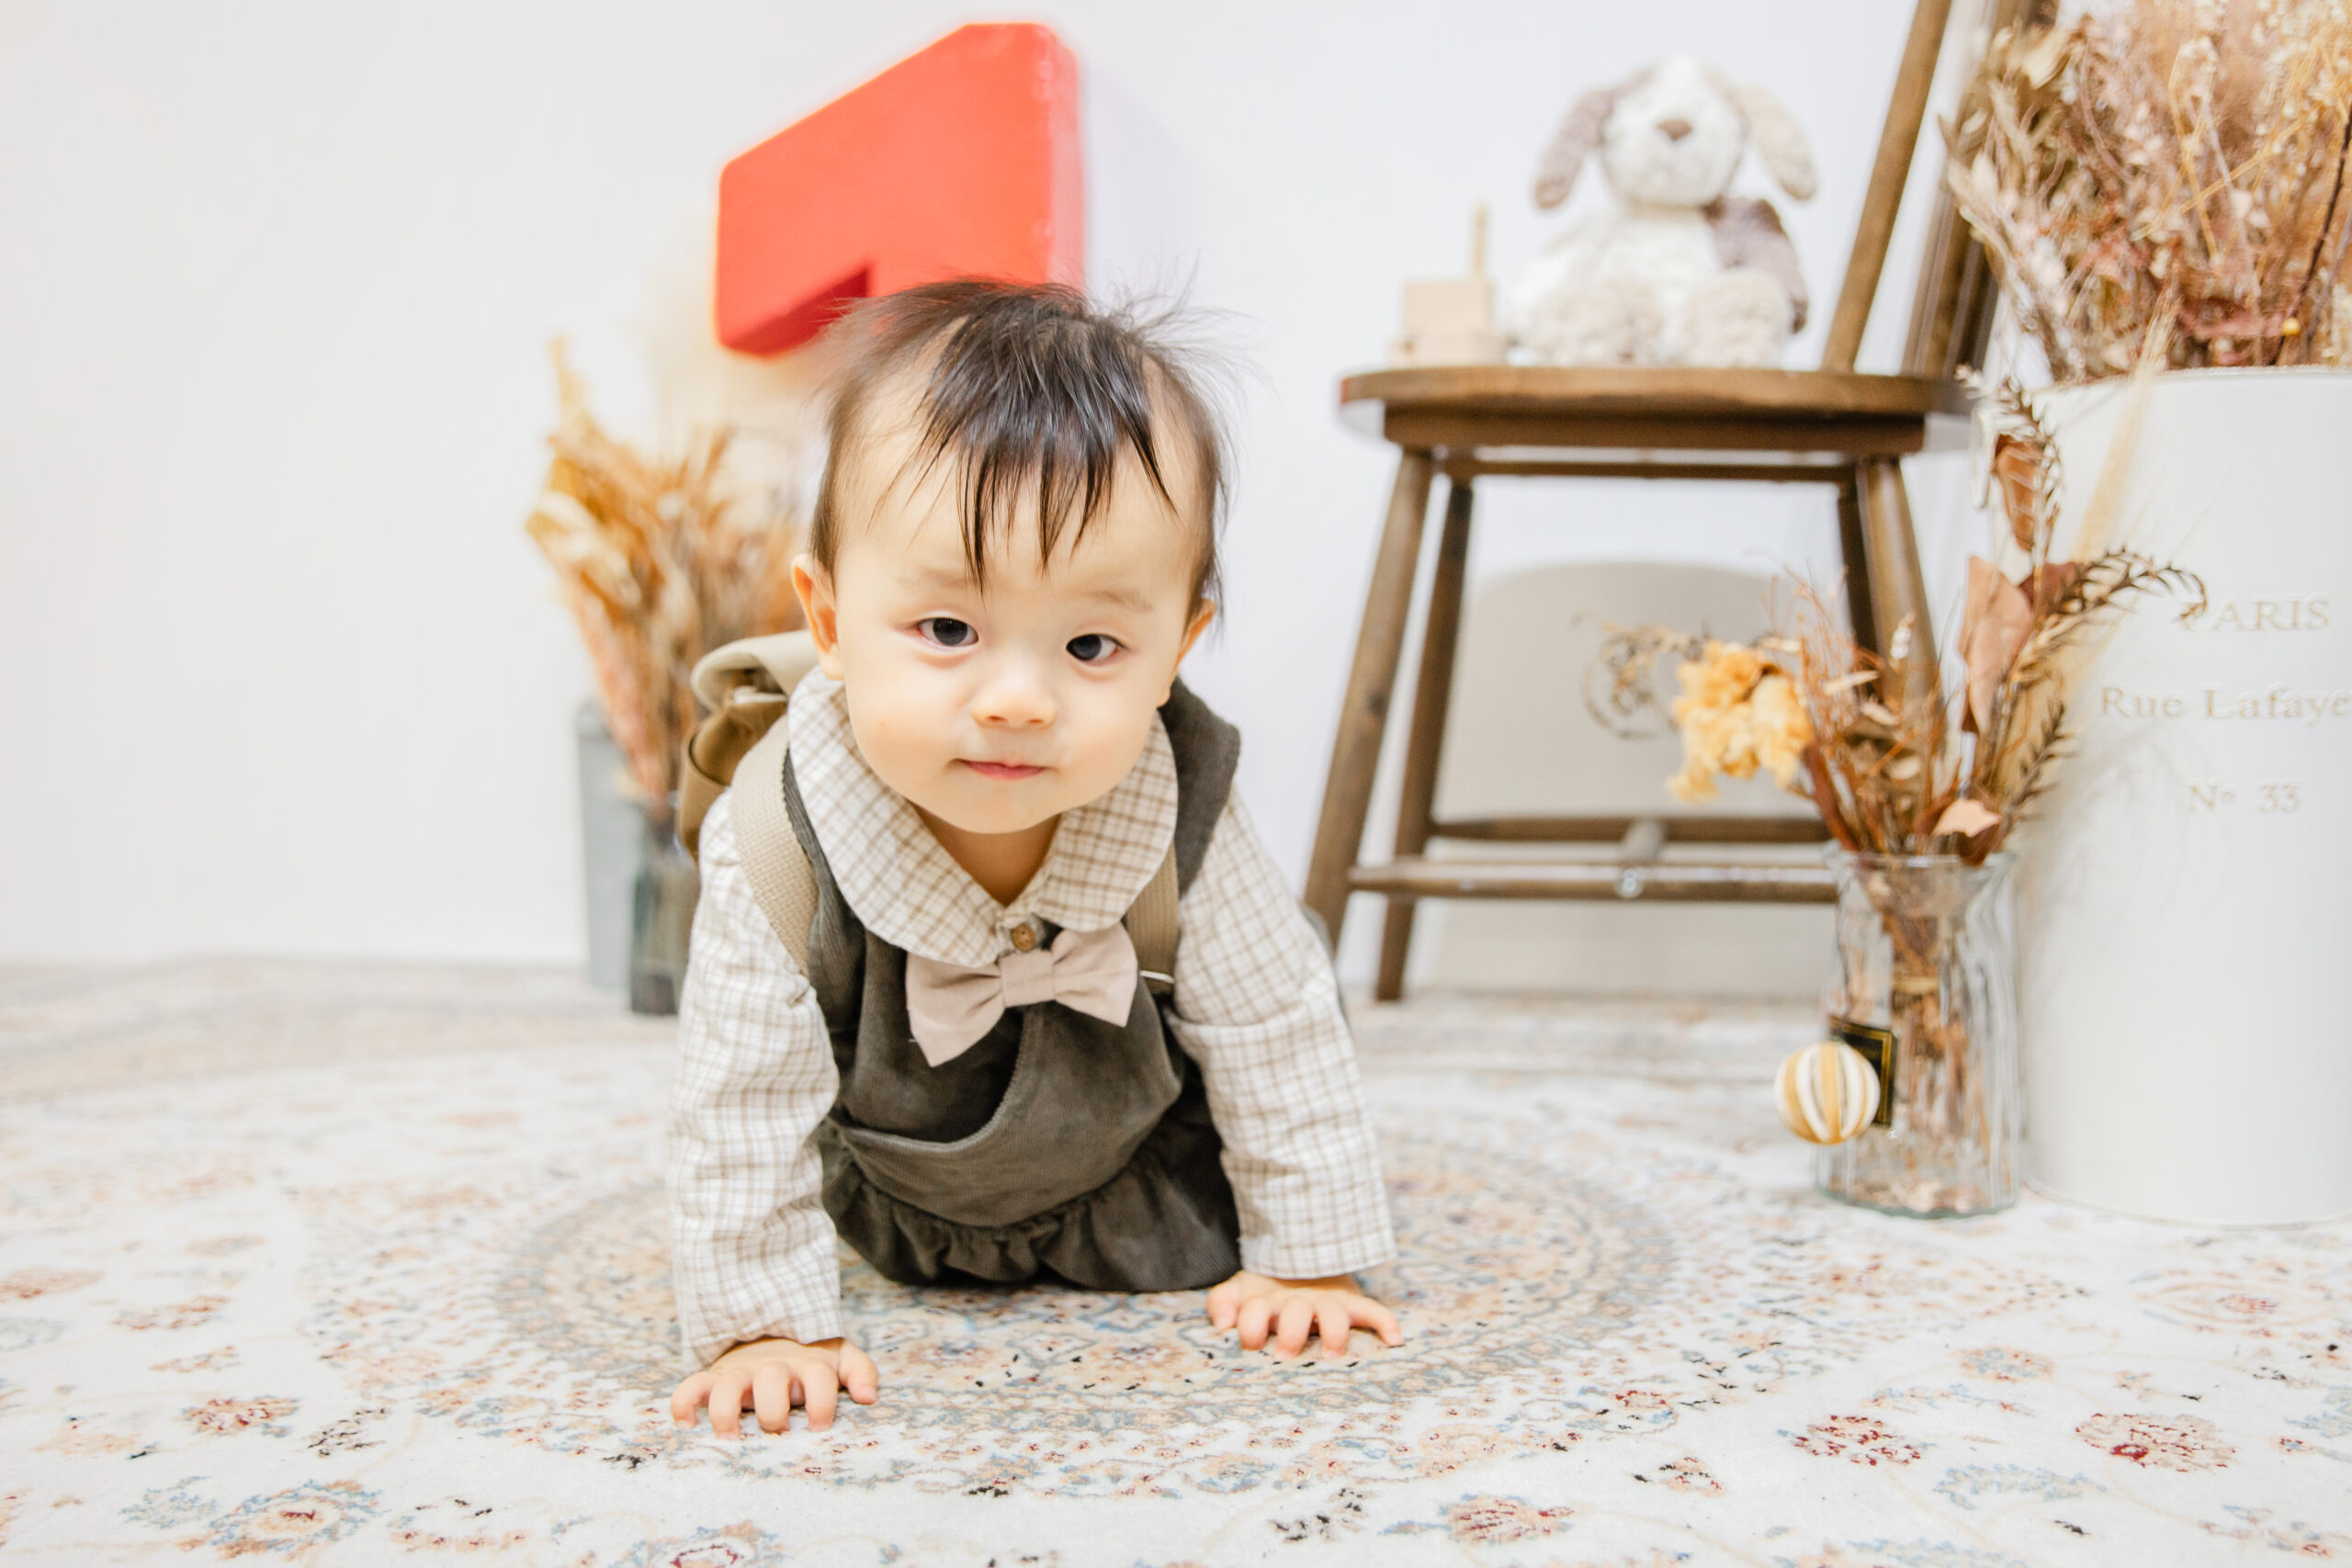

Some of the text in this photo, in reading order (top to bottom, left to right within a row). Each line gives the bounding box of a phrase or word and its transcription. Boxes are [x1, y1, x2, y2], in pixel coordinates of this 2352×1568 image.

[2099, 683, 2352, 728] Rue Lafaye
[2256, 781, 2301, 815] 33
